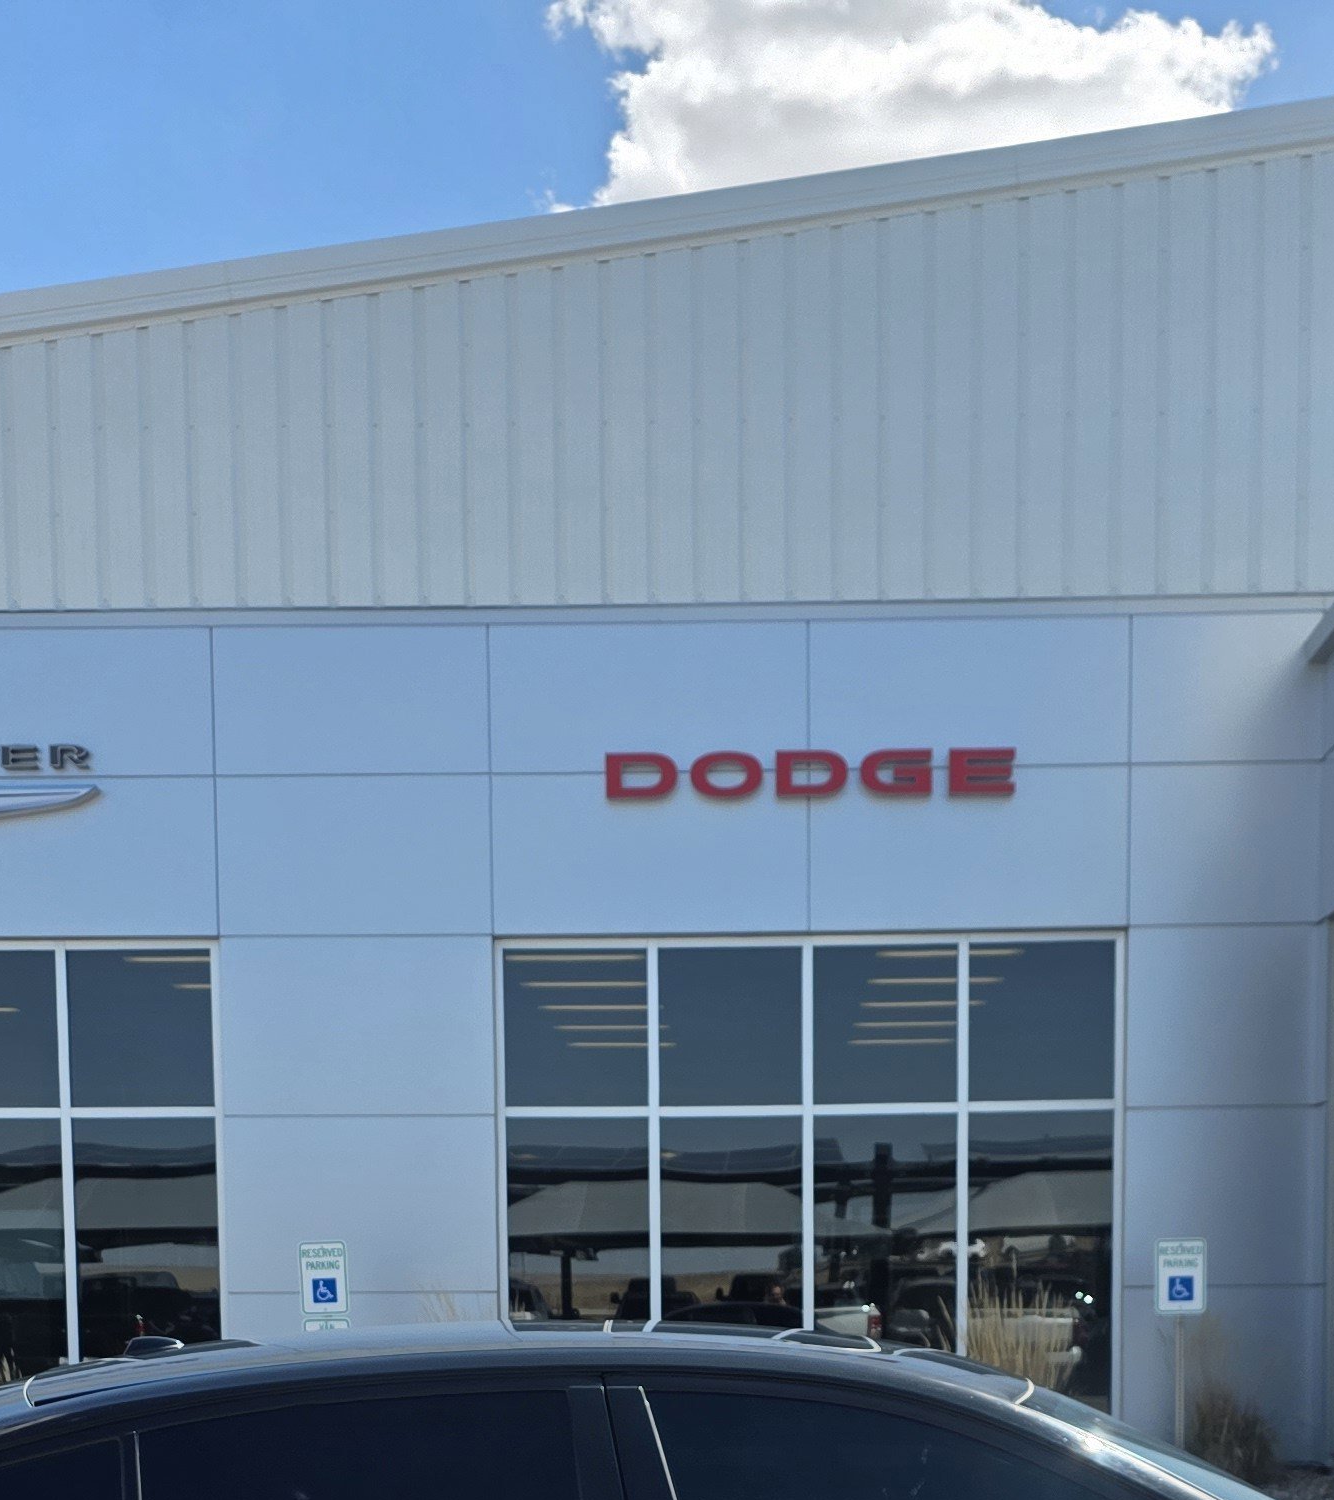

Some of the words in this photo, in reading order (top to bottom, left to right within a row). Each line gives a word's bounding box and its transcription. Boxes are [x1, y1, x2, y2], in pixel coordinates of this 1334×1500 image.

[605, 747, 1016, 799] DODGE
[301, 1248, 343, 1258] RESERVED
[306, 1260, 340, 1270] PARKING
